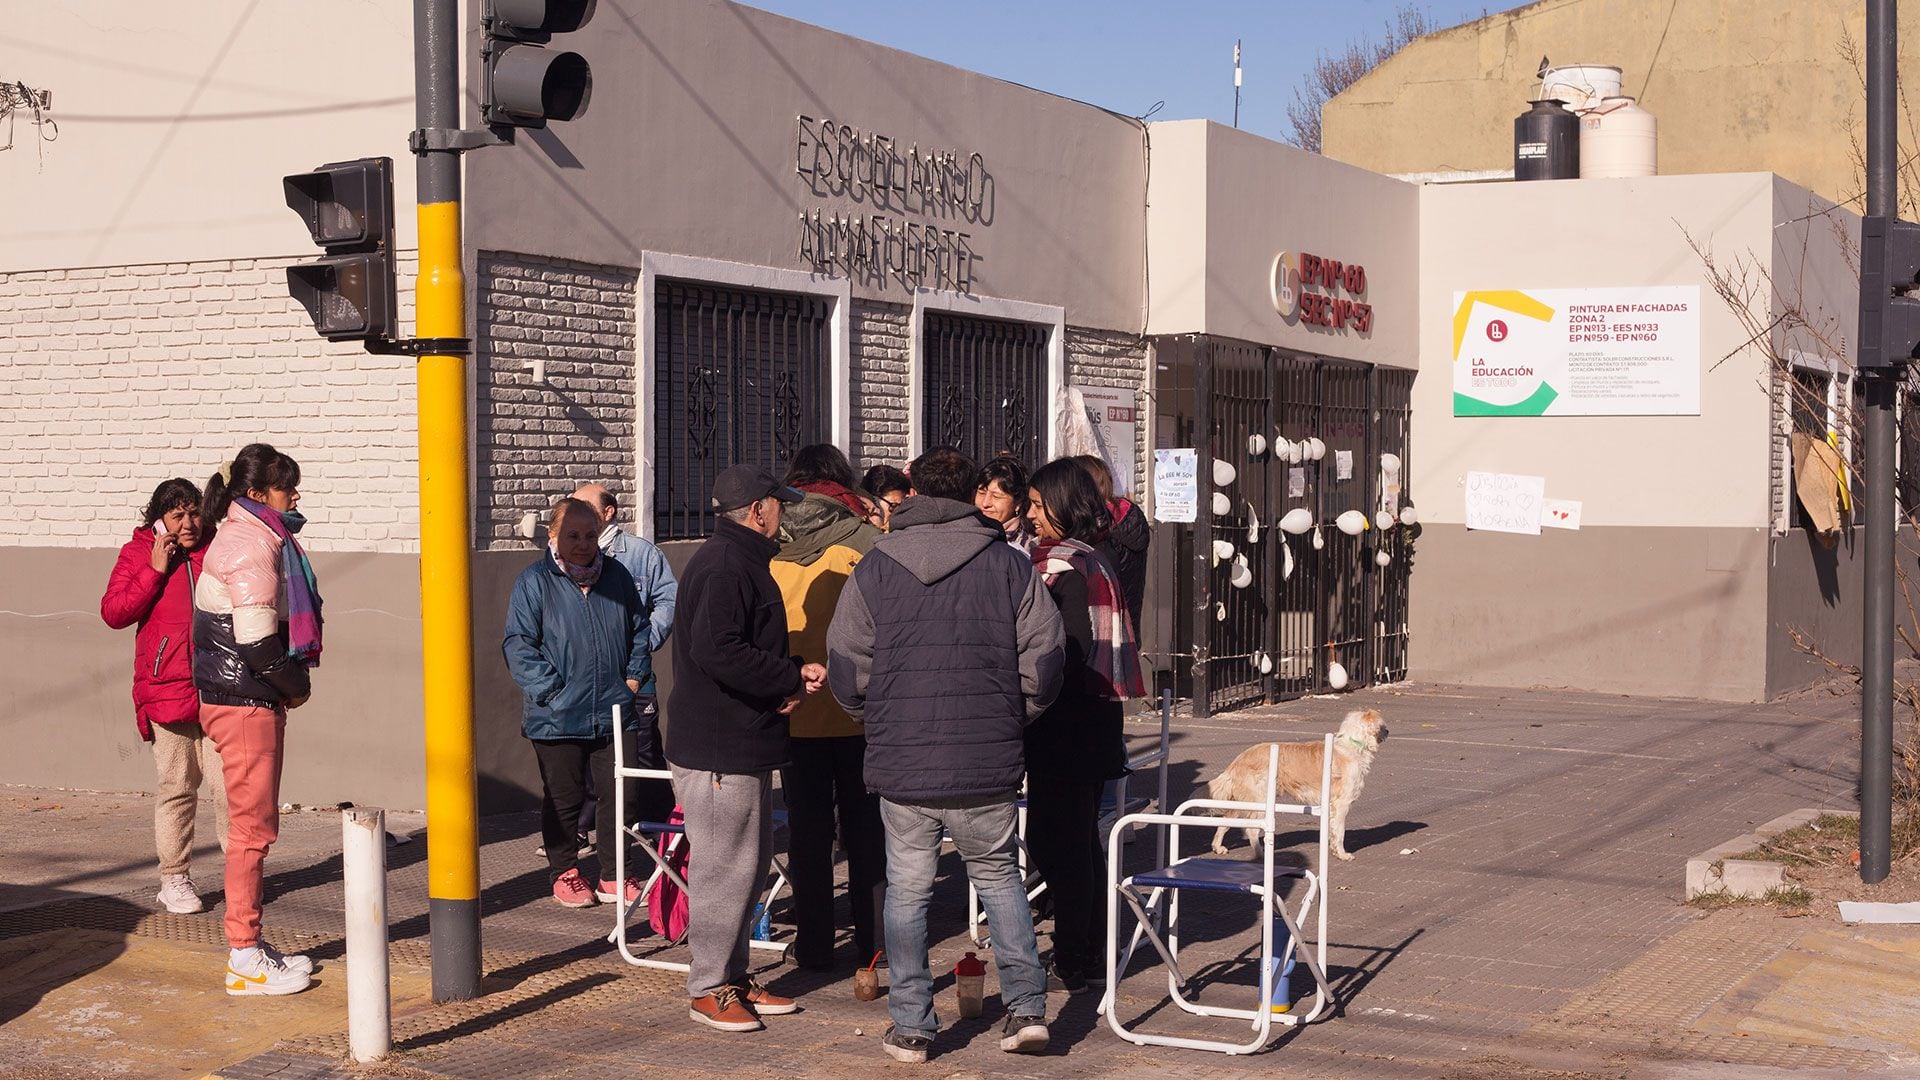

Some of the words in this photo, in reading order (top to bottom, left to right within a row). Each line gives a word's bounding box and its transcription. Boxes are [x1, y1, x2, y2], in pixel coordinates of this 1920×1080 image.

[797, 114, 924, 195] ESCUELA
[799, 207, 971, 284] ALMAFUERTE
[1569, 304, 1614, 313] PINTURA
[1616, 304, 1630, 312] EN
[1631, 304, 1688, 312] FACHADAS
[1569, 314, 1598, 322] ZONA
[1599, 314, 1605, 322] 2
[1569, 324, 1582, 332] EP
[1613, 324, 1632, 332] EES
[1569, 334, 1582, 342] EP
[1616, 334, 1629, 342] EP
[1472, 358, 1485, 366] LA
[1472, 366, 1533, 376] EDUCACIÓN
